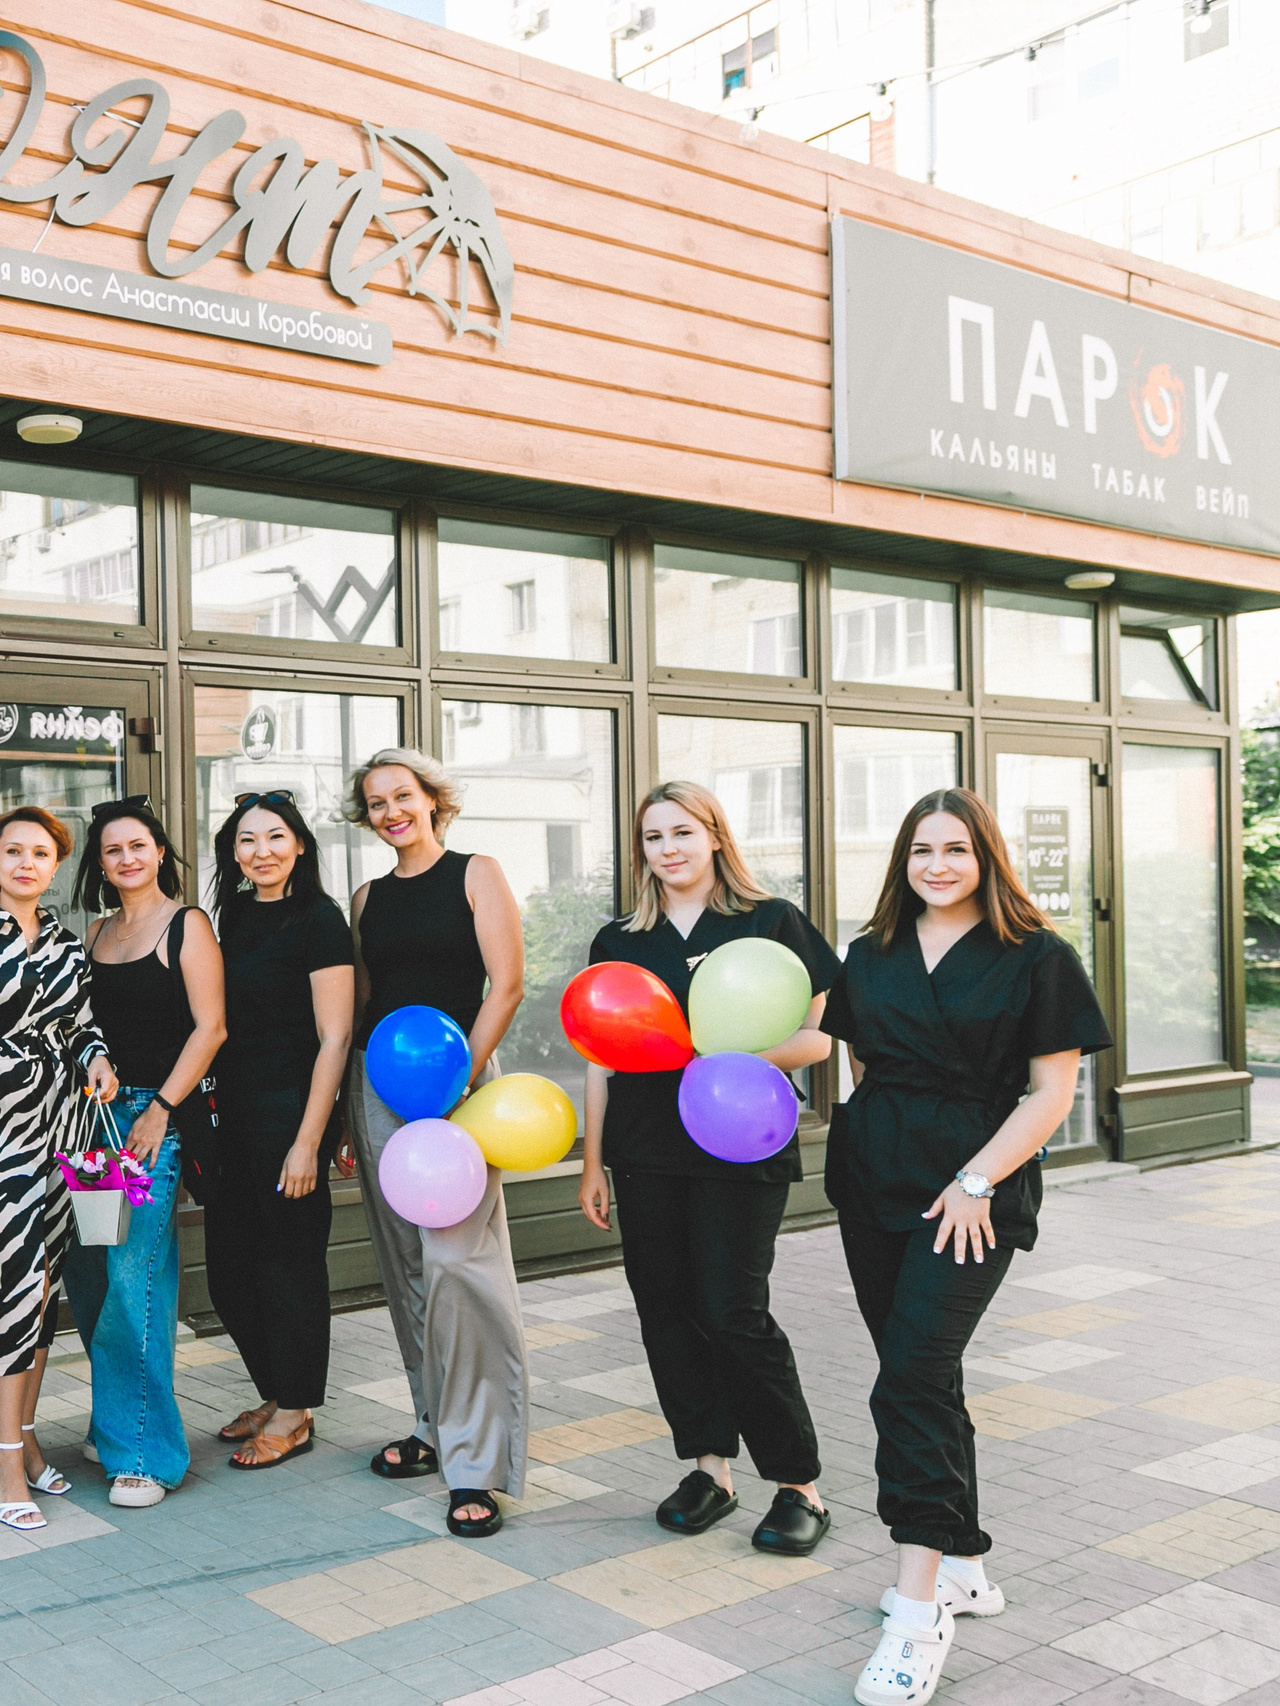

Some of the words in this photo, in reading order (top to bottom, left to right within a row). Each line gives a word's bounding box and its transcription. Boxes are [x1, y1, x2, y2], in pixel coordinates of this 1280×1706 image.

[20, 265, 93, 298] волос
[102, 272, 250, 328] Анастасии
[258, 302, 373, 351] Коробовой
[930, 428, 1057, 481] КАЛЬЯНЫ
[1092, 463, 1166, 503] ТАБАК
[1196, 485, 1250, 519] ВЕЙП
